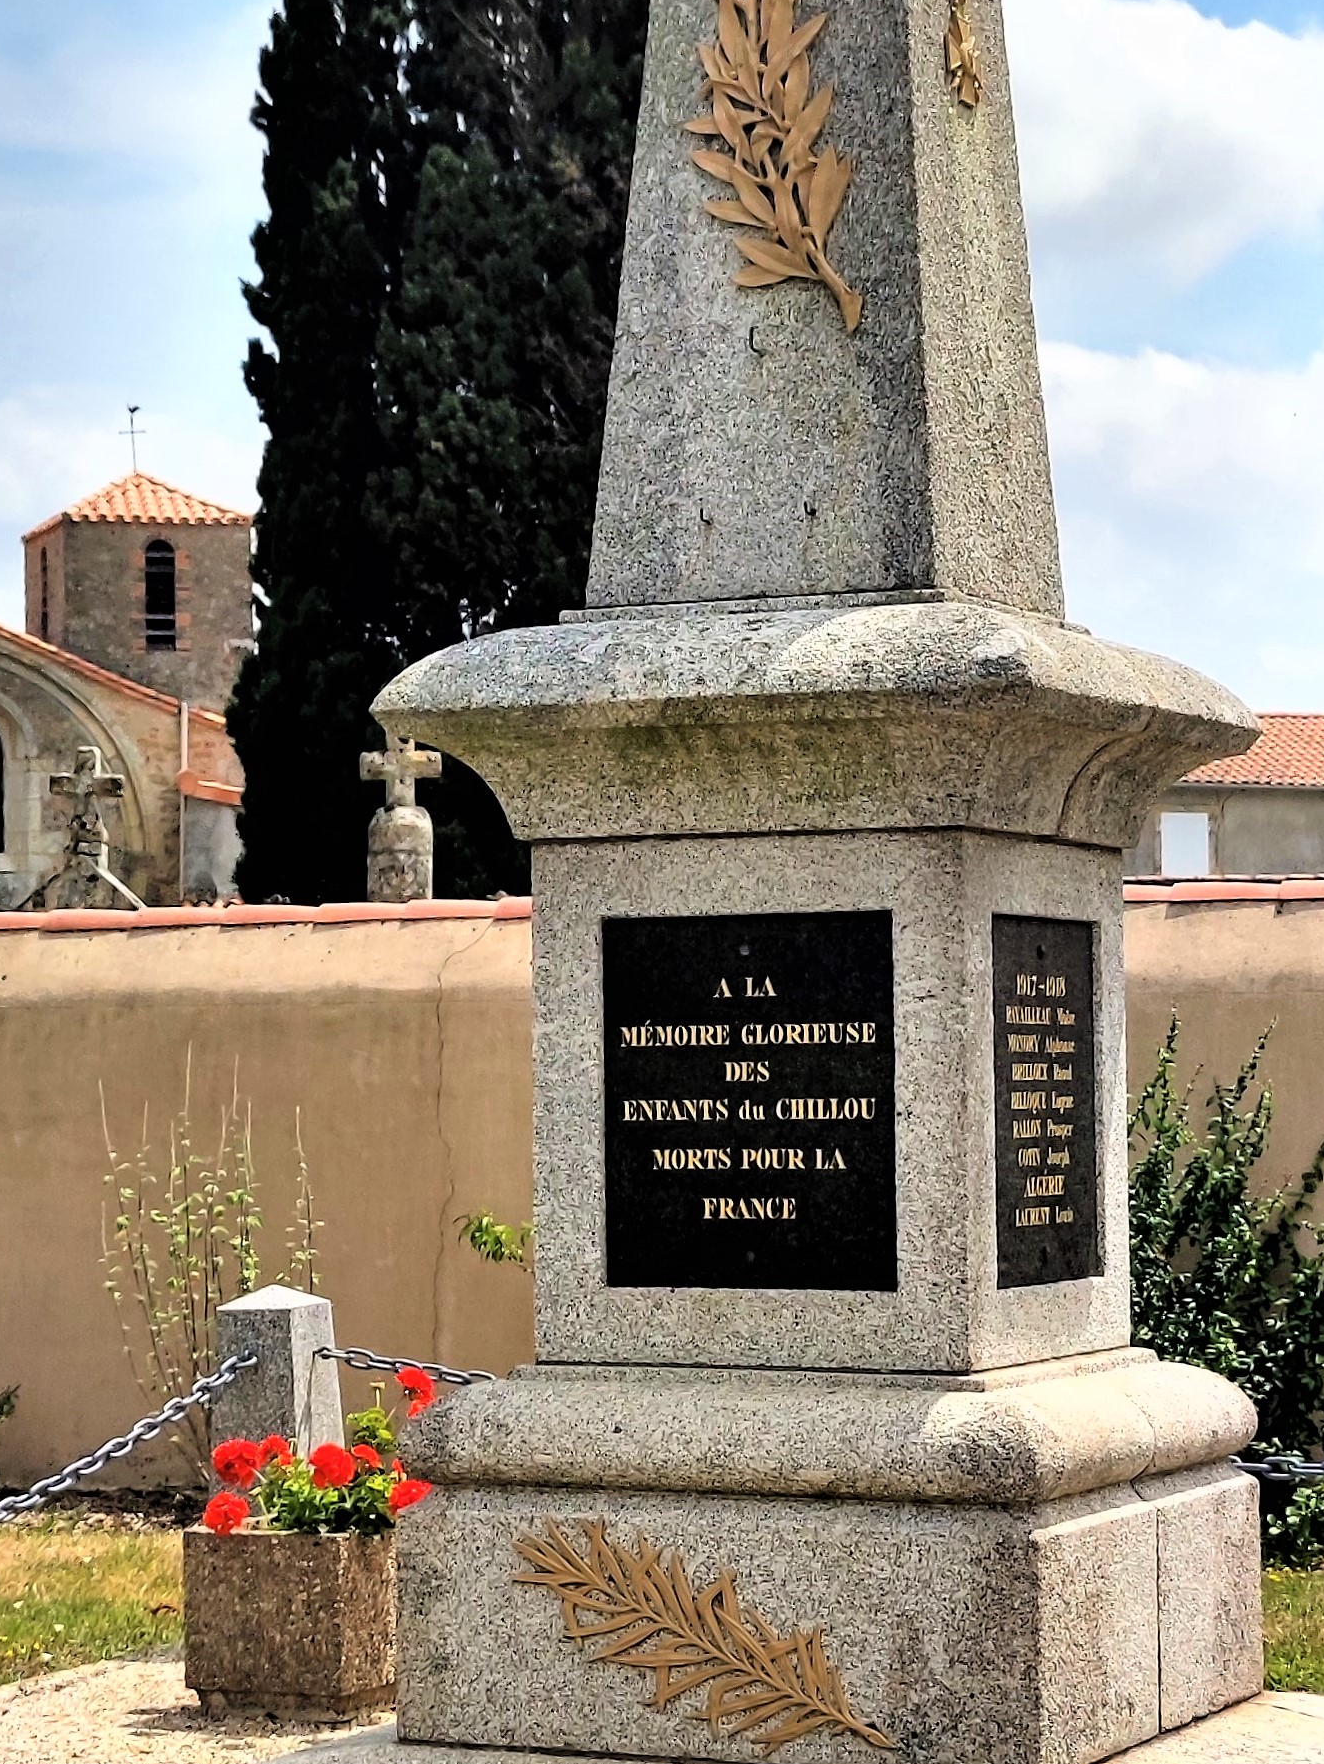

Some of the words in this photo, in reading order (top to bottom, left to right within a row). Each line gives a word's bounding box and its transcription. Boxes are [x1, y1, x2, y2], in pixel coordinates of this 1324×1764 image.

[713, 978, 732, 997] A
[745, 976, 776, 996] LA
[621, 1020, 729, 1047] MÉMOIRE
[742, 1022, 875, 1044] GLORIEUSE
[1045, 1036, 1074, 1057] Alphonse
[725, 1061, 769, 1083] DES
[623, 1099, 728, 1121] ENFANTS
[739, 1101, 765, 1120] du
[776, 1098, 875, 1119] CHILLOU
[1047, 1119, 1073, 1139] Prosper
[653, 1148, 731, 1169] MORTS
[741, 1148, 805, 1169] POUR
[816, 1149, 846, 1169] LA
[1047, 1146, 1069, 1168] Joseph
[1024, 1169, 1064, 1197] ALGÉRIE
[703, 1197, 795, 1219] FRANCE
[1016, 1207, 1049, 1227] LAURENT
[1056, 1206, 1073, 1223] Louis
